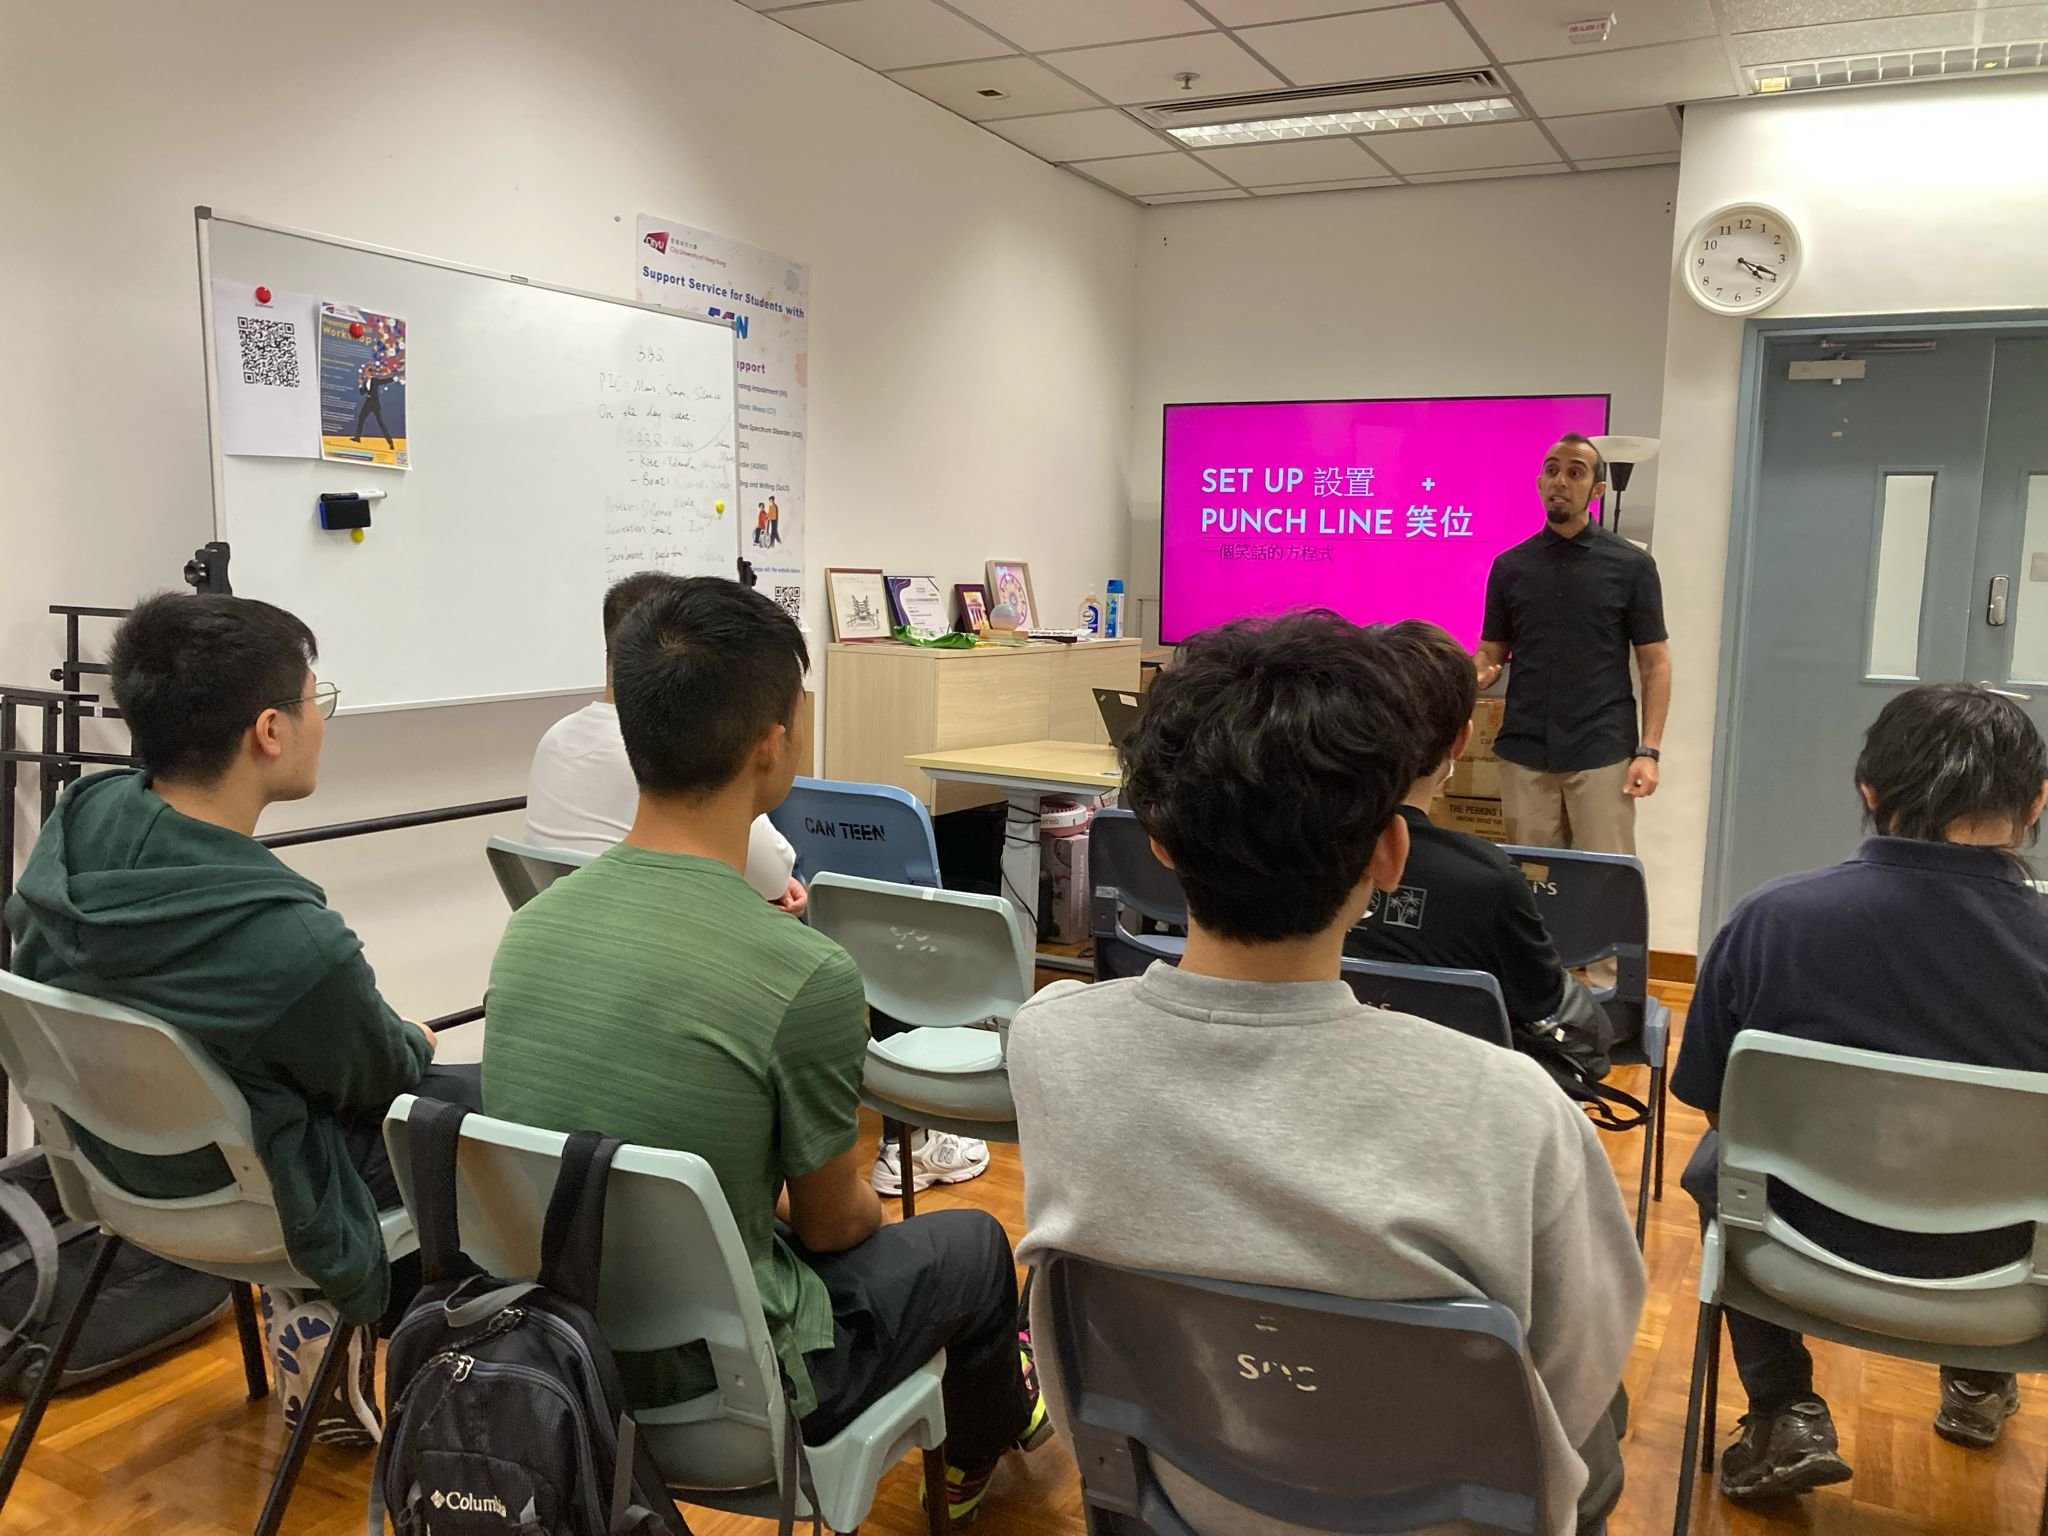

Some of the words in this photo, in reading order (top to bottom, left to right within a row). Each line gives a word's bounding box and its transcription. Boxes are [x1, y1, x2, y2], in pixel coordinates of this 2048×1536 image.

[1739, 219, 1752, 230] 12
[1760, 223, 1766, 233] 1
[1719, 225, 1732, 236] 11
[1773, 234, 1781, 245] 2
[1703, 240, 1718, 251] 10
[1698, 258, 1705, 269] 9
[1778, 254, 1786, 265] 3
[1702, 276, 1710, 286] 8
[642, 266, 685, 287] Support
[688, 278, 728, 298] Service
[730, 288, 743, 302] for
[745, 293, 783, 313] Students
[785, 307, 805, 319] with
[1716, 287, 1723, 298] 7
[1734, 293, 1742, 303] 6
[1754, 287, 1762, 298] 5
[321, 325, 373, 345] Worksop
[1201, 468, 1254, 493] SET
[1264, 468, 1304, 493] UP
[1313, 466, 1376, 498] 設置
[1201, 508, 1306, 533] PUNCH
[1318, 508, 1393, 535] LINE
[1405, 505, 1474, 538] 笑位
[1201, 543, 1334, 562] 一個笑話的方程式
[1450, 804, 1464, 813] THE
[1465, 806, 1497, 816] PERKINS
[805, 817, 836, 838] CAN
[839, 823, 886, 841] TEEN
